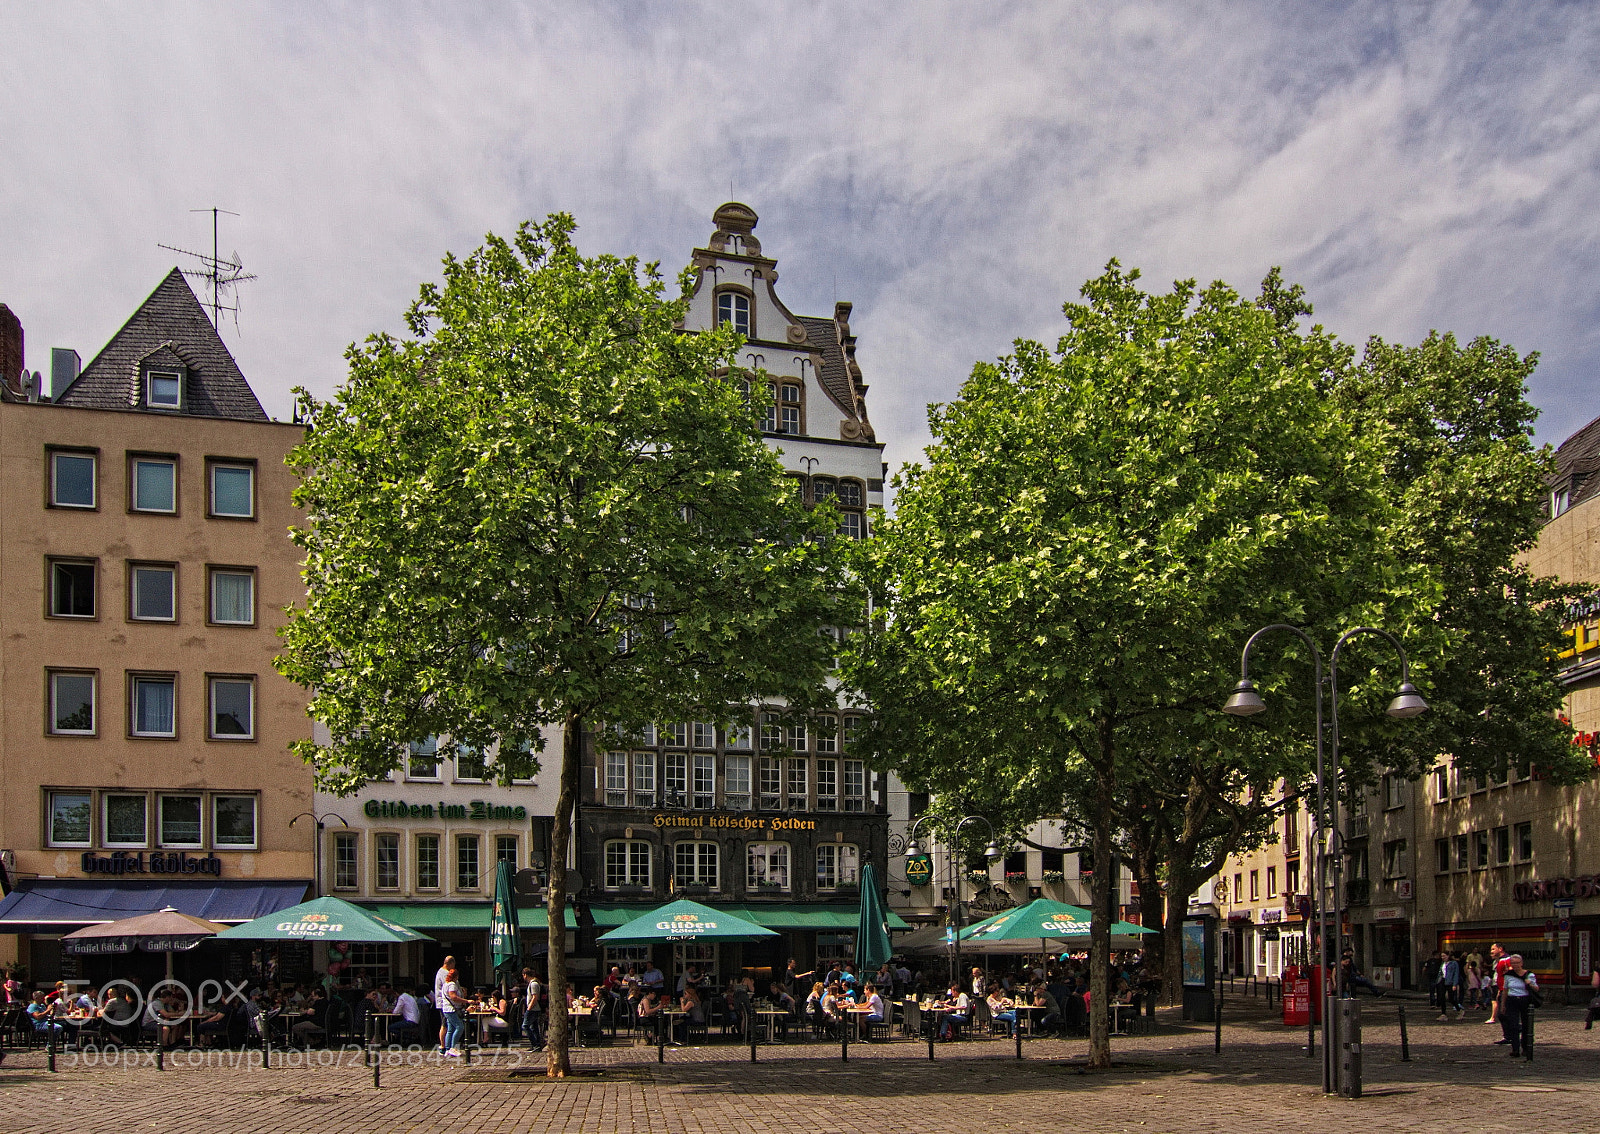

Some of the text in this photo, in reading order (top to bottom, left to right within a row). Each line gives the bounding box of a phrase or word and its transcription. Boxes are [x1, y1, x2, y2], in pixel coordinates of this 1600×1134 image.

[364, 799, 527, 820] Gilden im Zims
[653, 813, 815, 831] Heimat kölscher Helden
[81, 851, 147, 875] Gaffel
[276, 922, 344, 932] Gilden
[656, 921, 718, 930] Gilden
[75, 942, 127, 953] Gaffel Kölsch
[147, 940, 197, 950] Gaffel Köls
